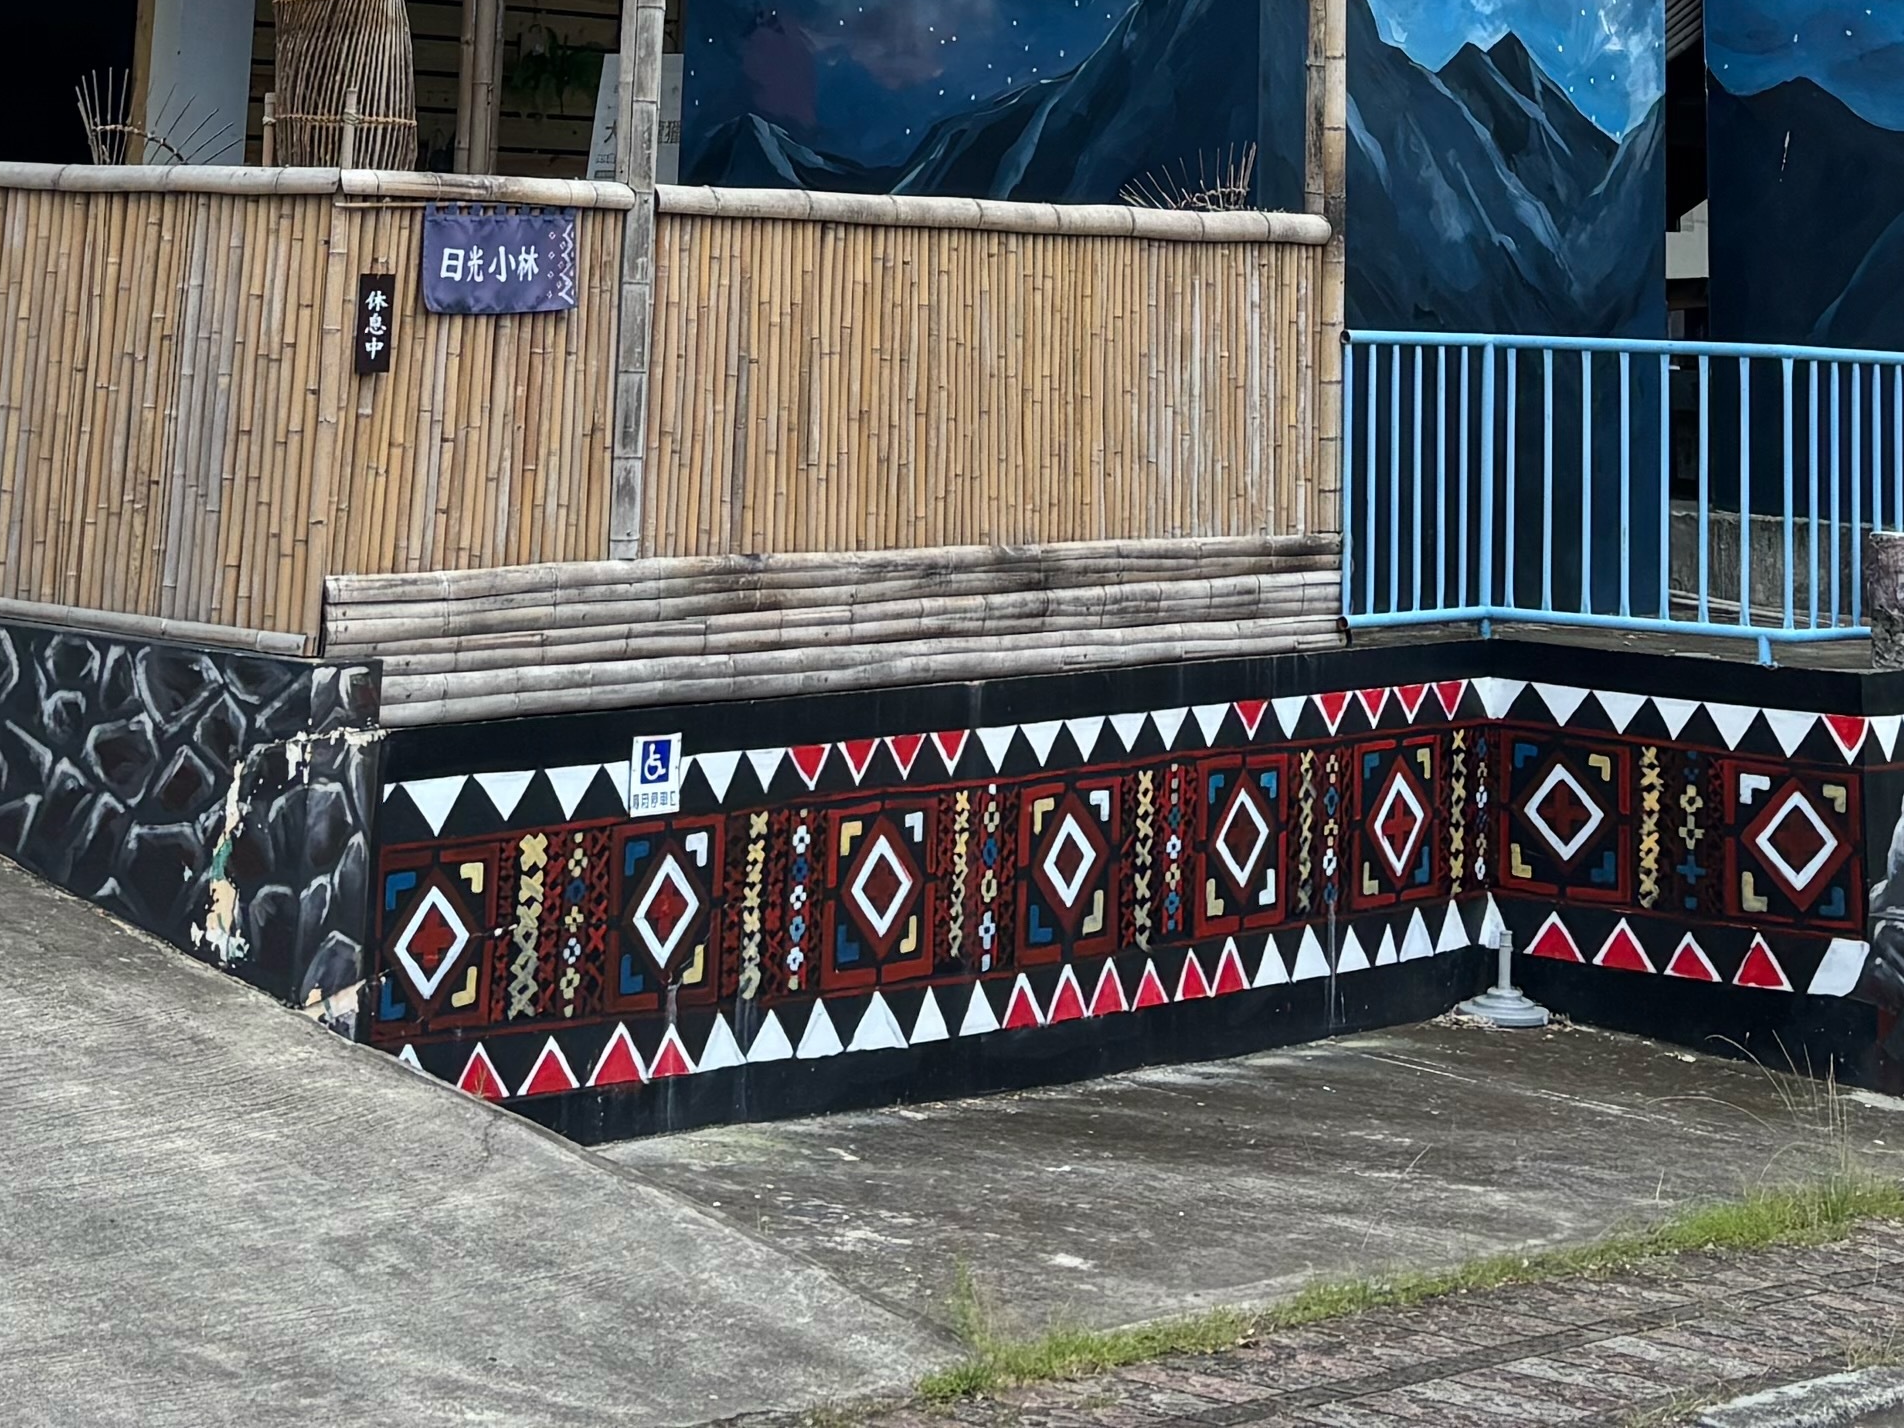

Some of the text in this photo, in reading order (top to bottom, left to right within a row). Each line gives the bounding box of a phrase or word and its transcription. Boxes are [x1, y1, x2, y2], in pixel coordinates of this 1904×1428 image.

[439, 245, 539, 283] 日光小林
[363, 290, 389, 361] 休息中
